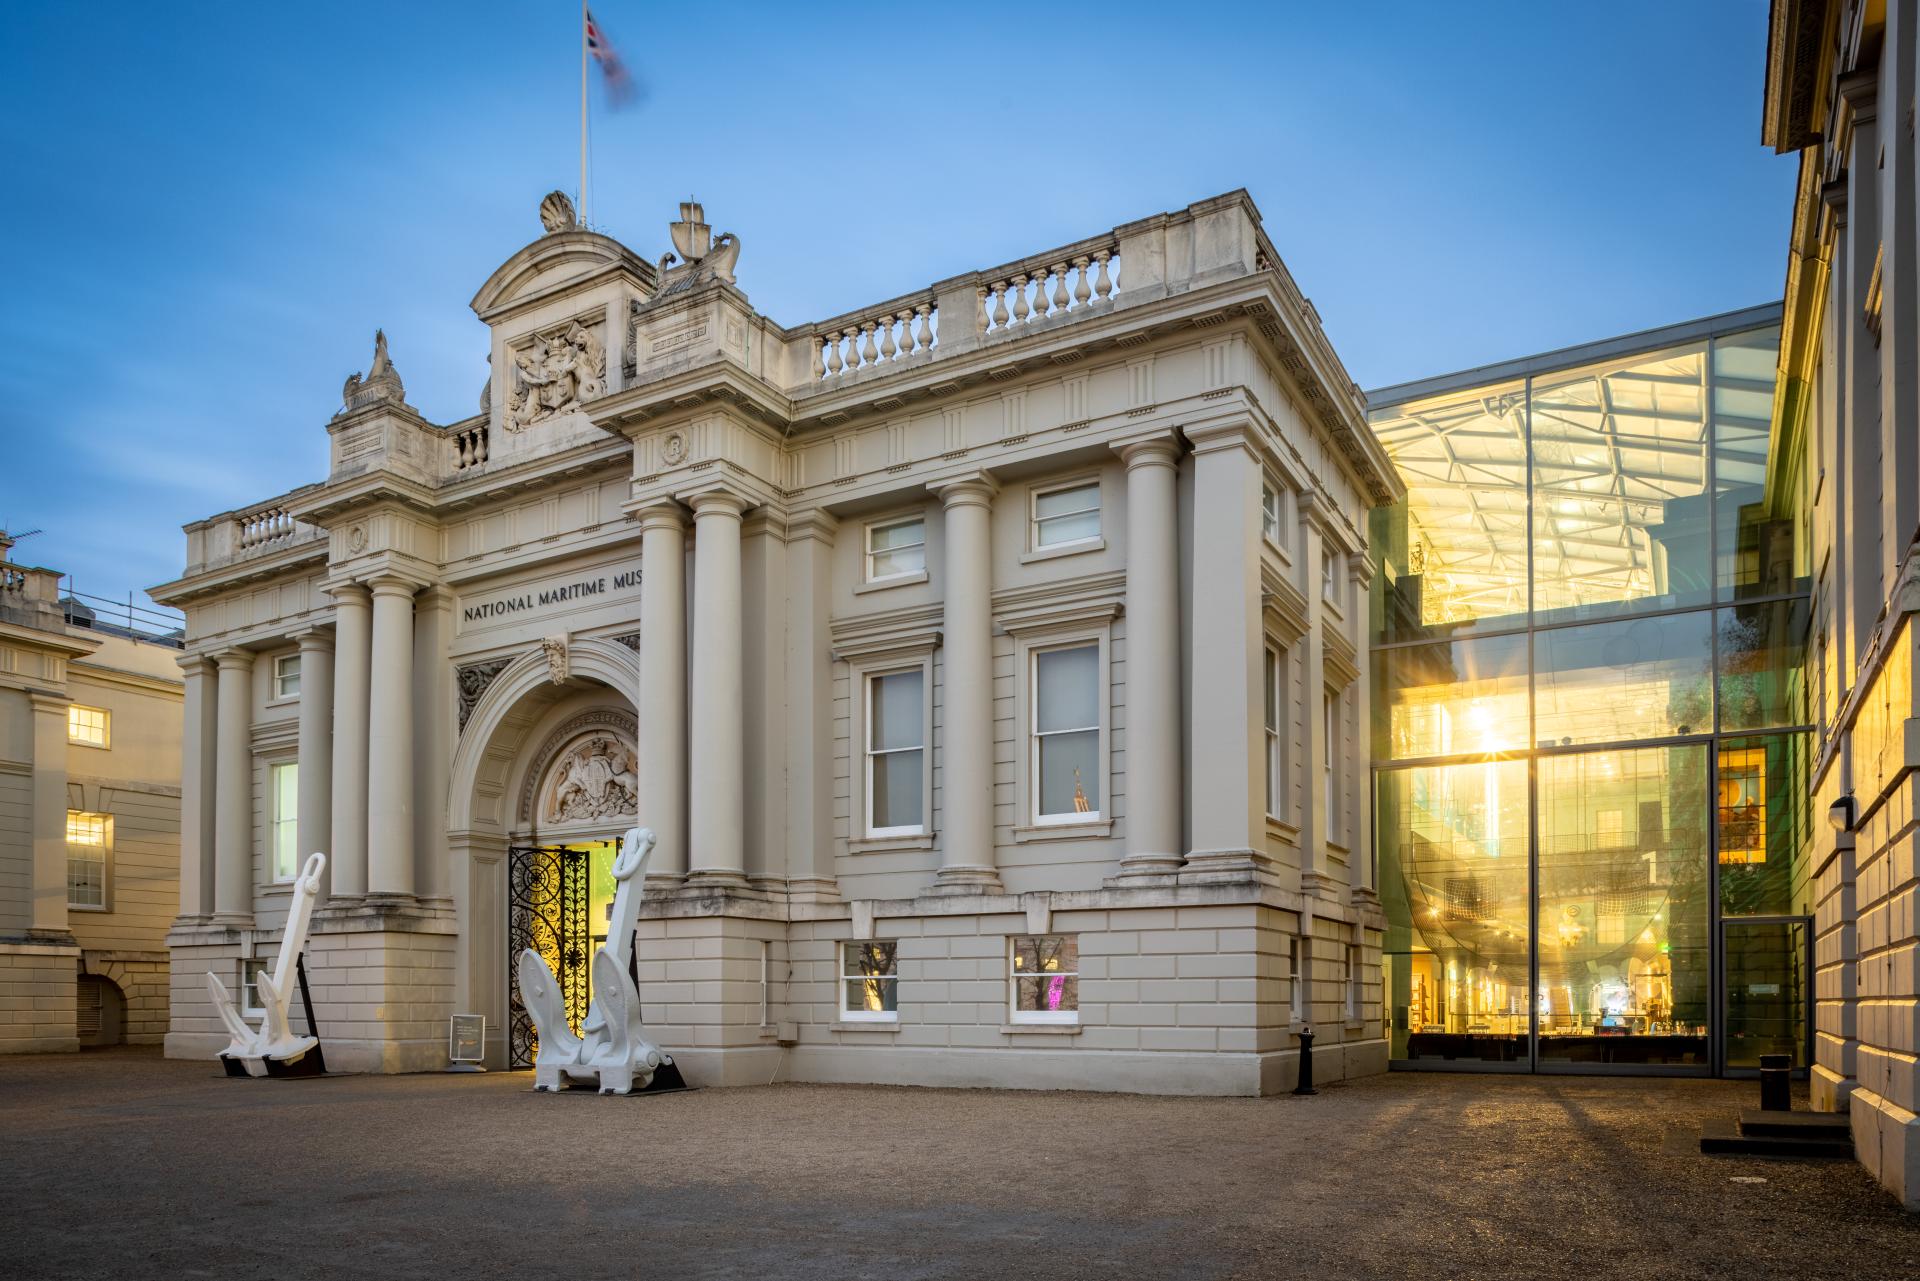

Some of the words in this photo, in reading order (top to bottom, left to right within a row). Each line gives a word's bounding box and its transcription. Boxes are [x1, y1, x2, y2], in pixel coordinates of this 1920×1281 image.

[464, 594, 534, 622] NATIONAL
[538, 578, 606, 607] MARITIME
[613, 569, 643, 590] MUS
[1641, 850, 1657, 884] 1
